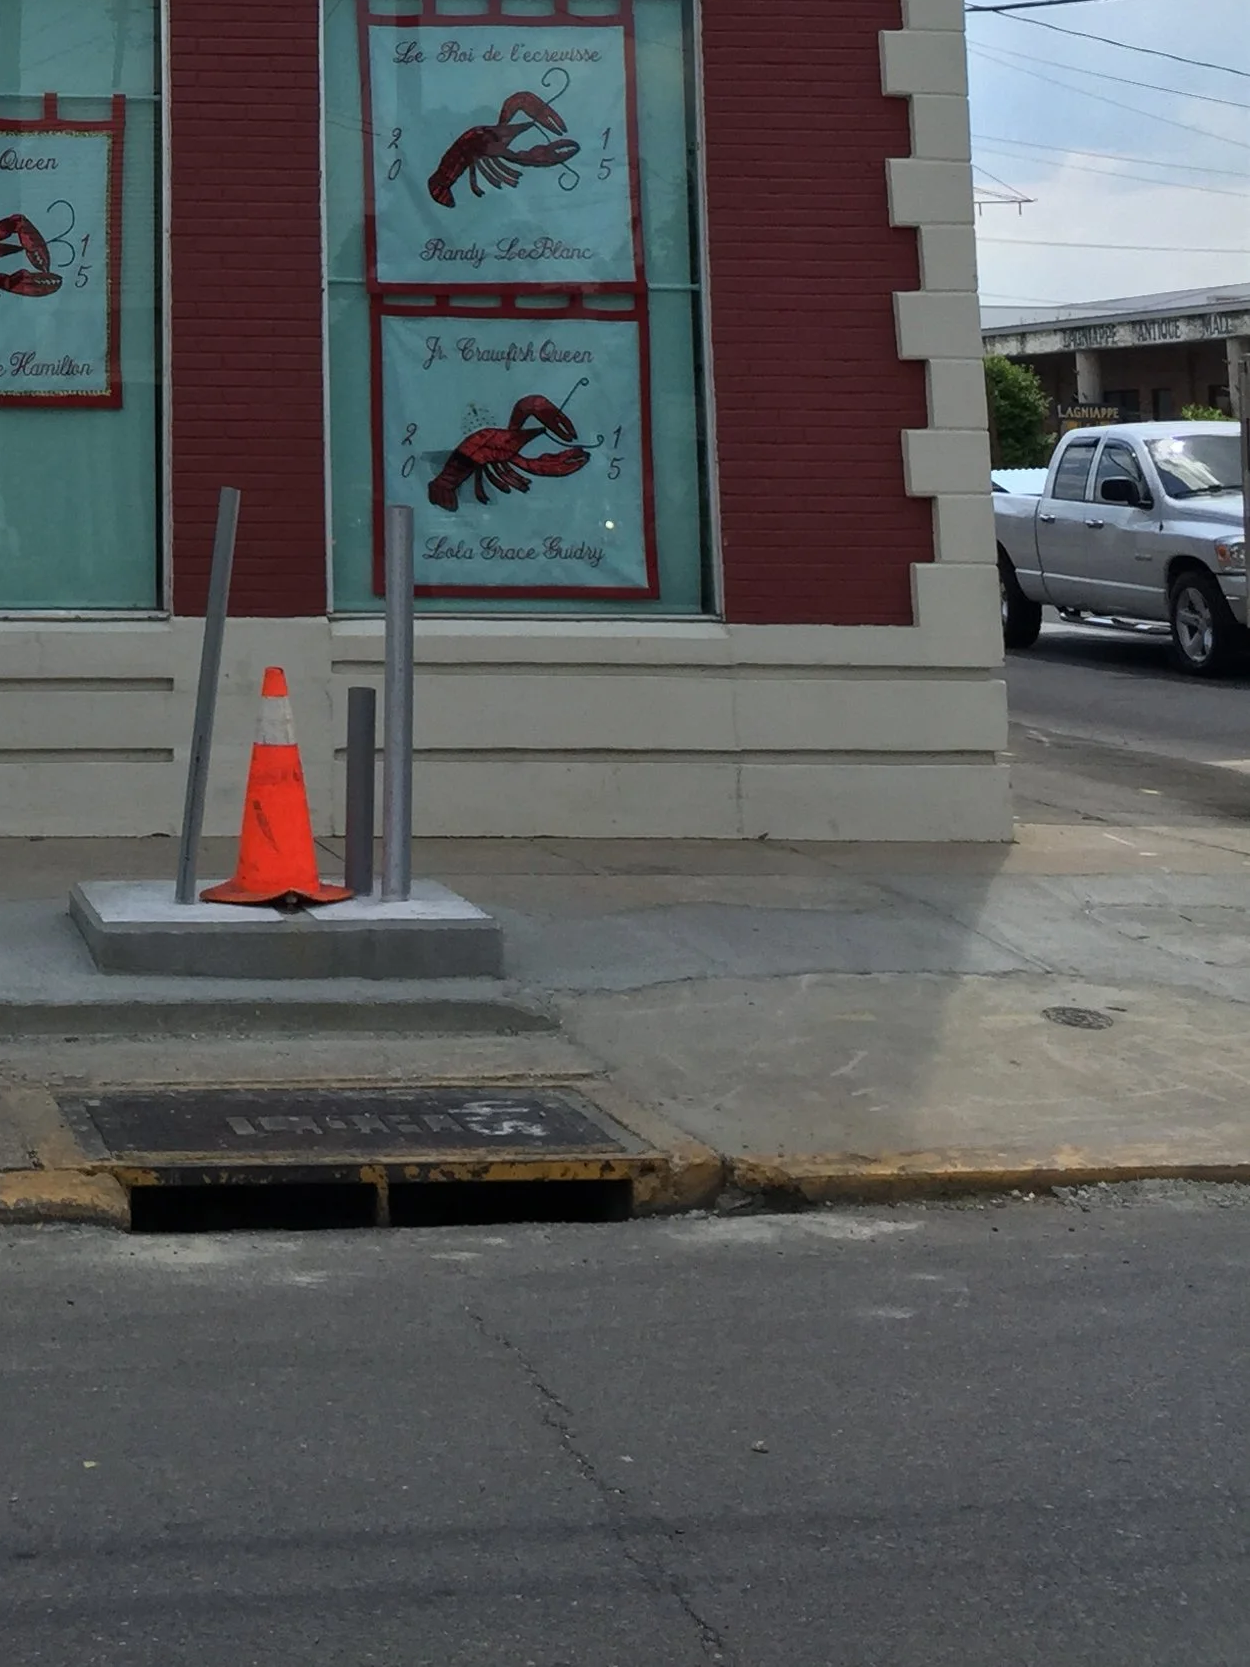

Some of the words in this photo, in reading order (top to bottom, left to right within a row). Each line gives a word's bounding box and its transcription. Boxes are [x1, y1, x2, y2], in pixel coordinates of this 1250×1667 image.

[393, 40, 427, 63] Le
[436, 40, 475, 63] Roi
[482, 43, 503, 63] de
[419, 238, 487, 270] Randy
[9, 351, 94, 377] Hamilton
[456, 337, 536, 371] Crawfish
[538, 339, 594, 364] Queen
[1057, 404, 1120, 419] LAGNIAPPE
[422, 536, 475, 561] Lola
[479, 536, 541, 561] Grace
[542, 536, 607, 568] Guidry
